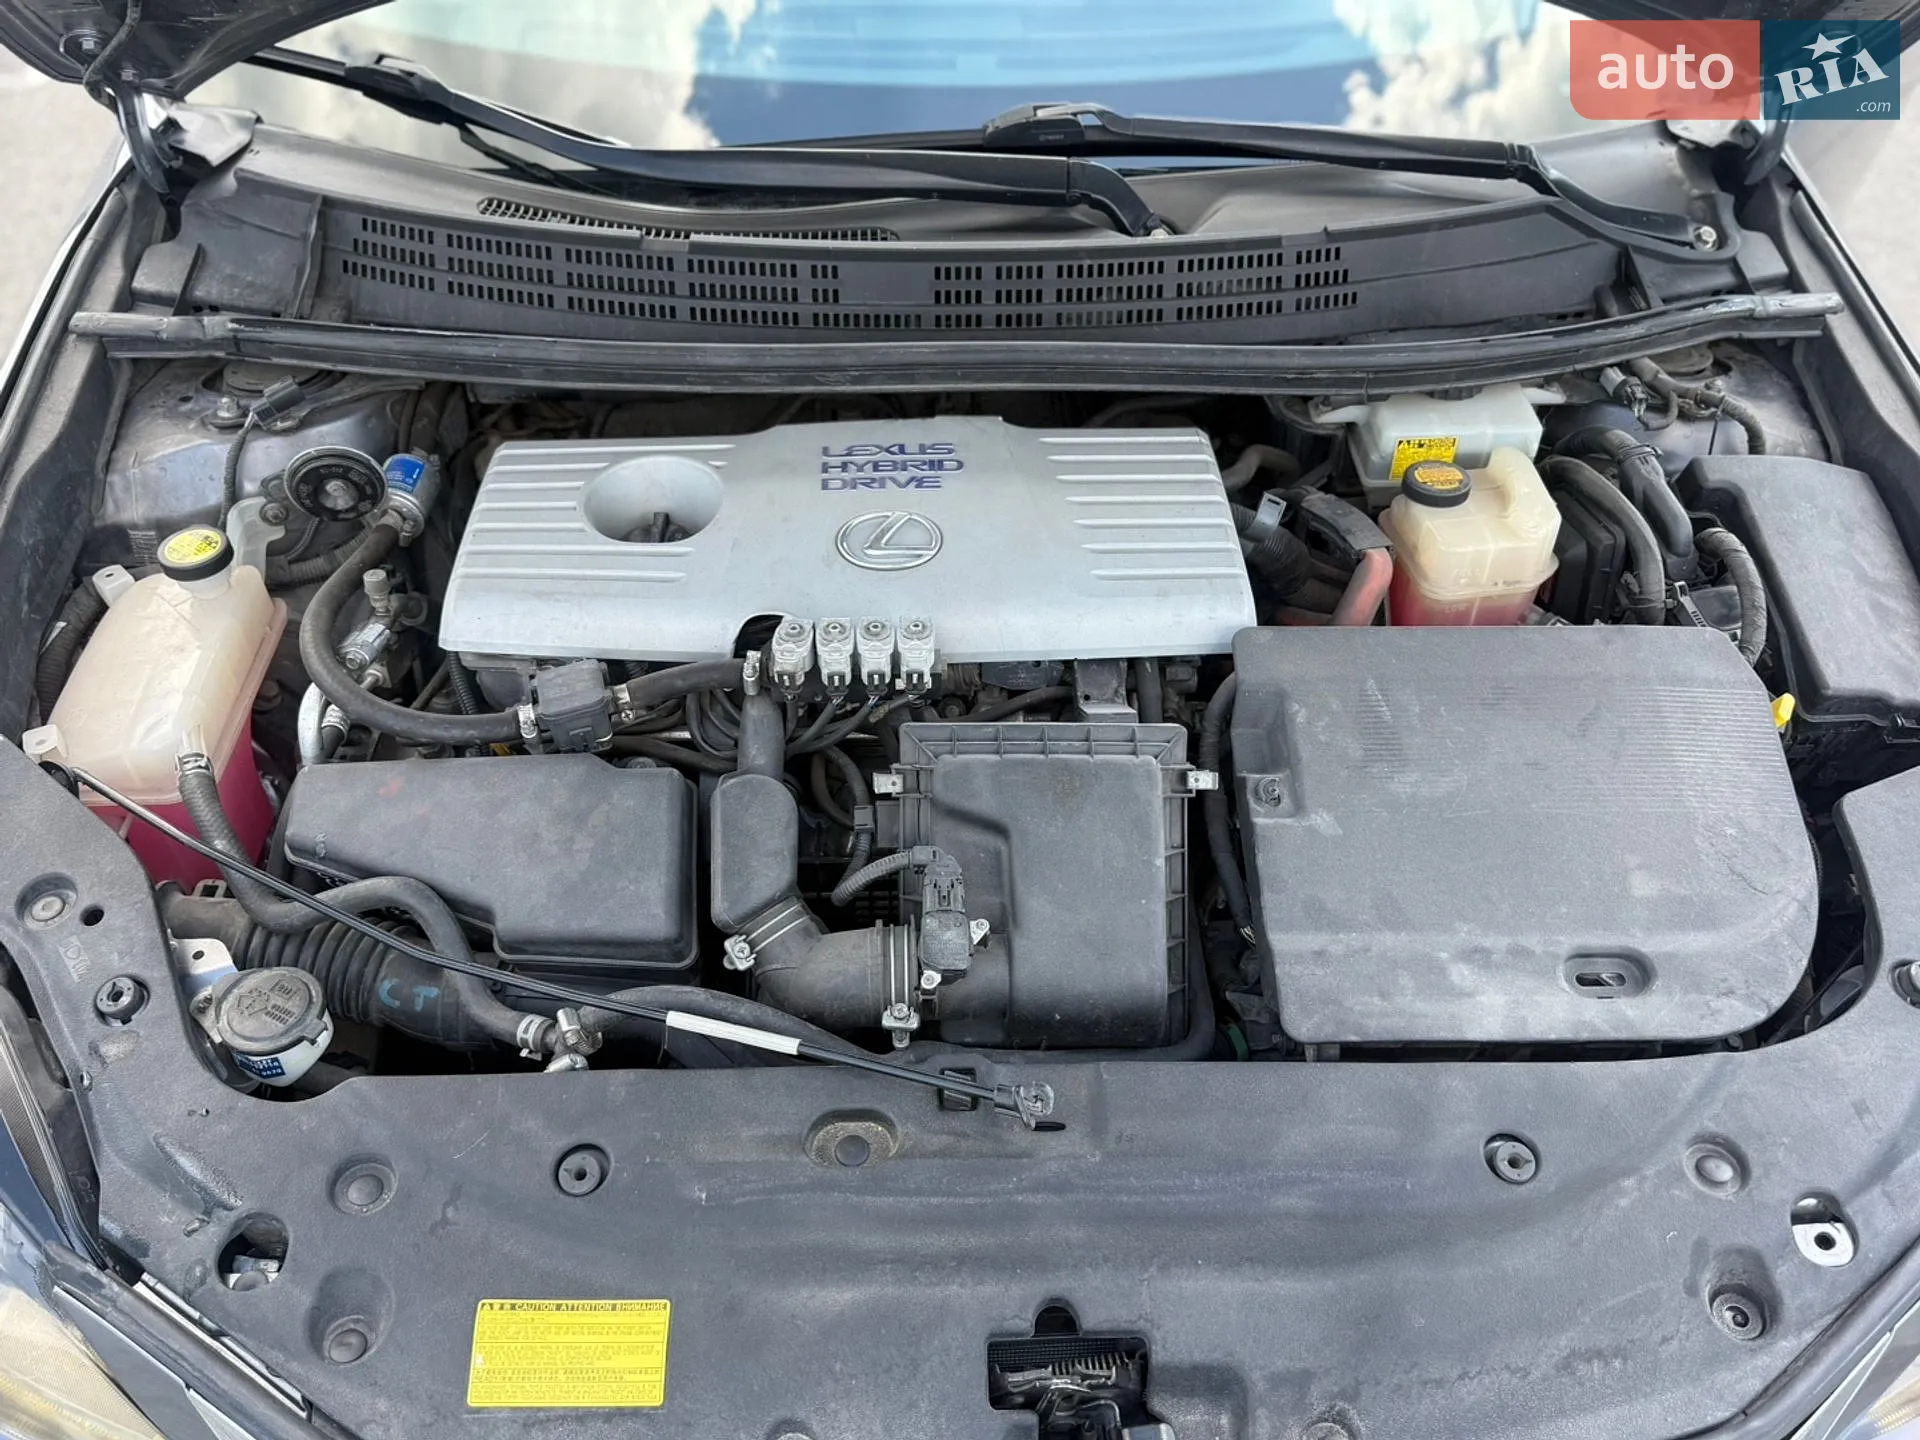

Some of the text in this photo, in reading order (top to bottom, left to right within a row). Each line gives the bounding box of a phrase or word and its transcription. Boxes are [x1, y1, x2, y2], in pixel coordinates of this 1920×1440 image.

[821, 442, 955, 458] LEXUS
[821, 458, 965, 474] HYBRID
[821, 475, 942, 491] DRIVE
[515, 1302, 666, 1312] CAUTION ATTENTION ВНИМАНИЕ
